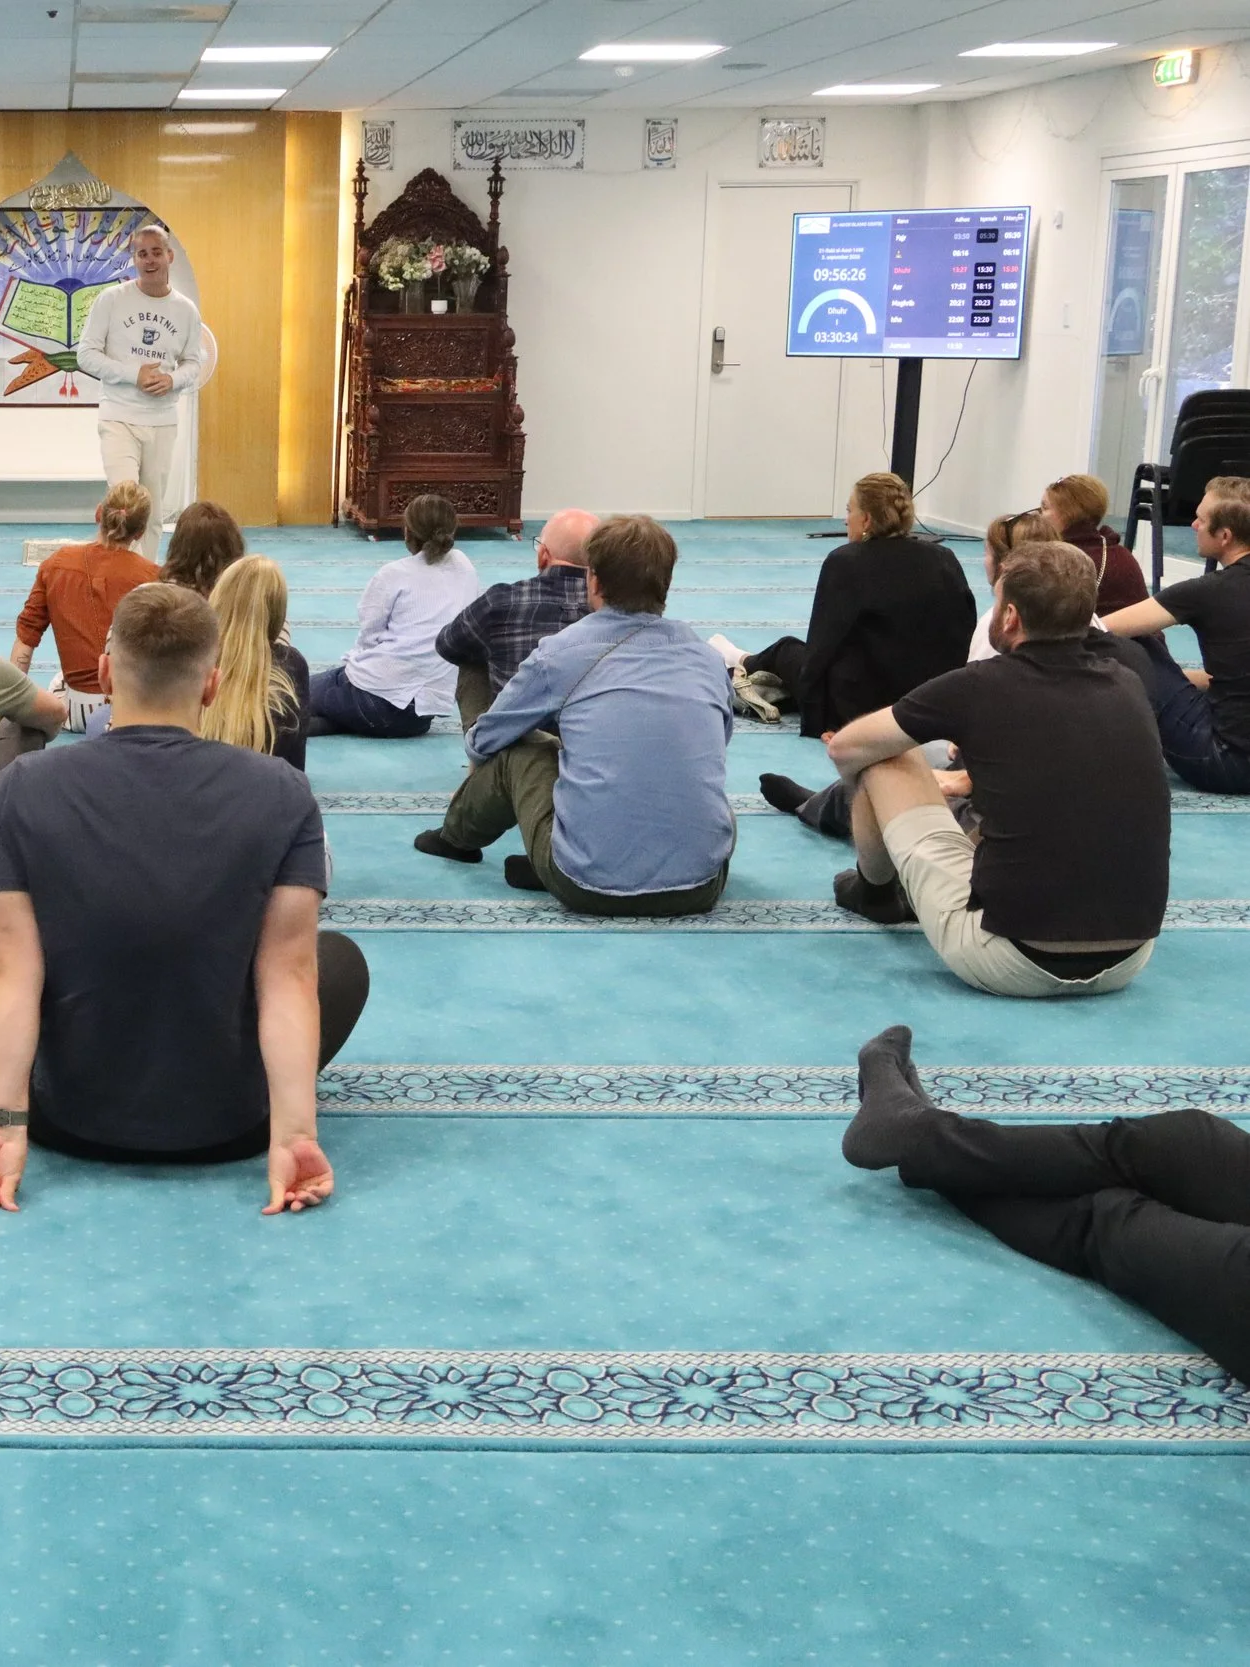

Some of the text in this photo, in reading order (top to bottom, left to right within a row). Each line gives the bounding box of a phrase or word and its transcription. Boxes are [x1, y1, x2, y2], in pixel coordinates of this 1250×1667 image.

[895, 234, 907, 242] Fajr
[813, 268, 867, 282] 09:56:26
[976, 282, 992, 290] 18:15
[974, 299, 991, 307] 20:23
[828, 307, 848, 315] Dhuhr
[973, 315, 990, 323] 22:20
[123, 312, 178, 337] LE BEATNIK
[814, 332, 858, 343] 03:30:34
